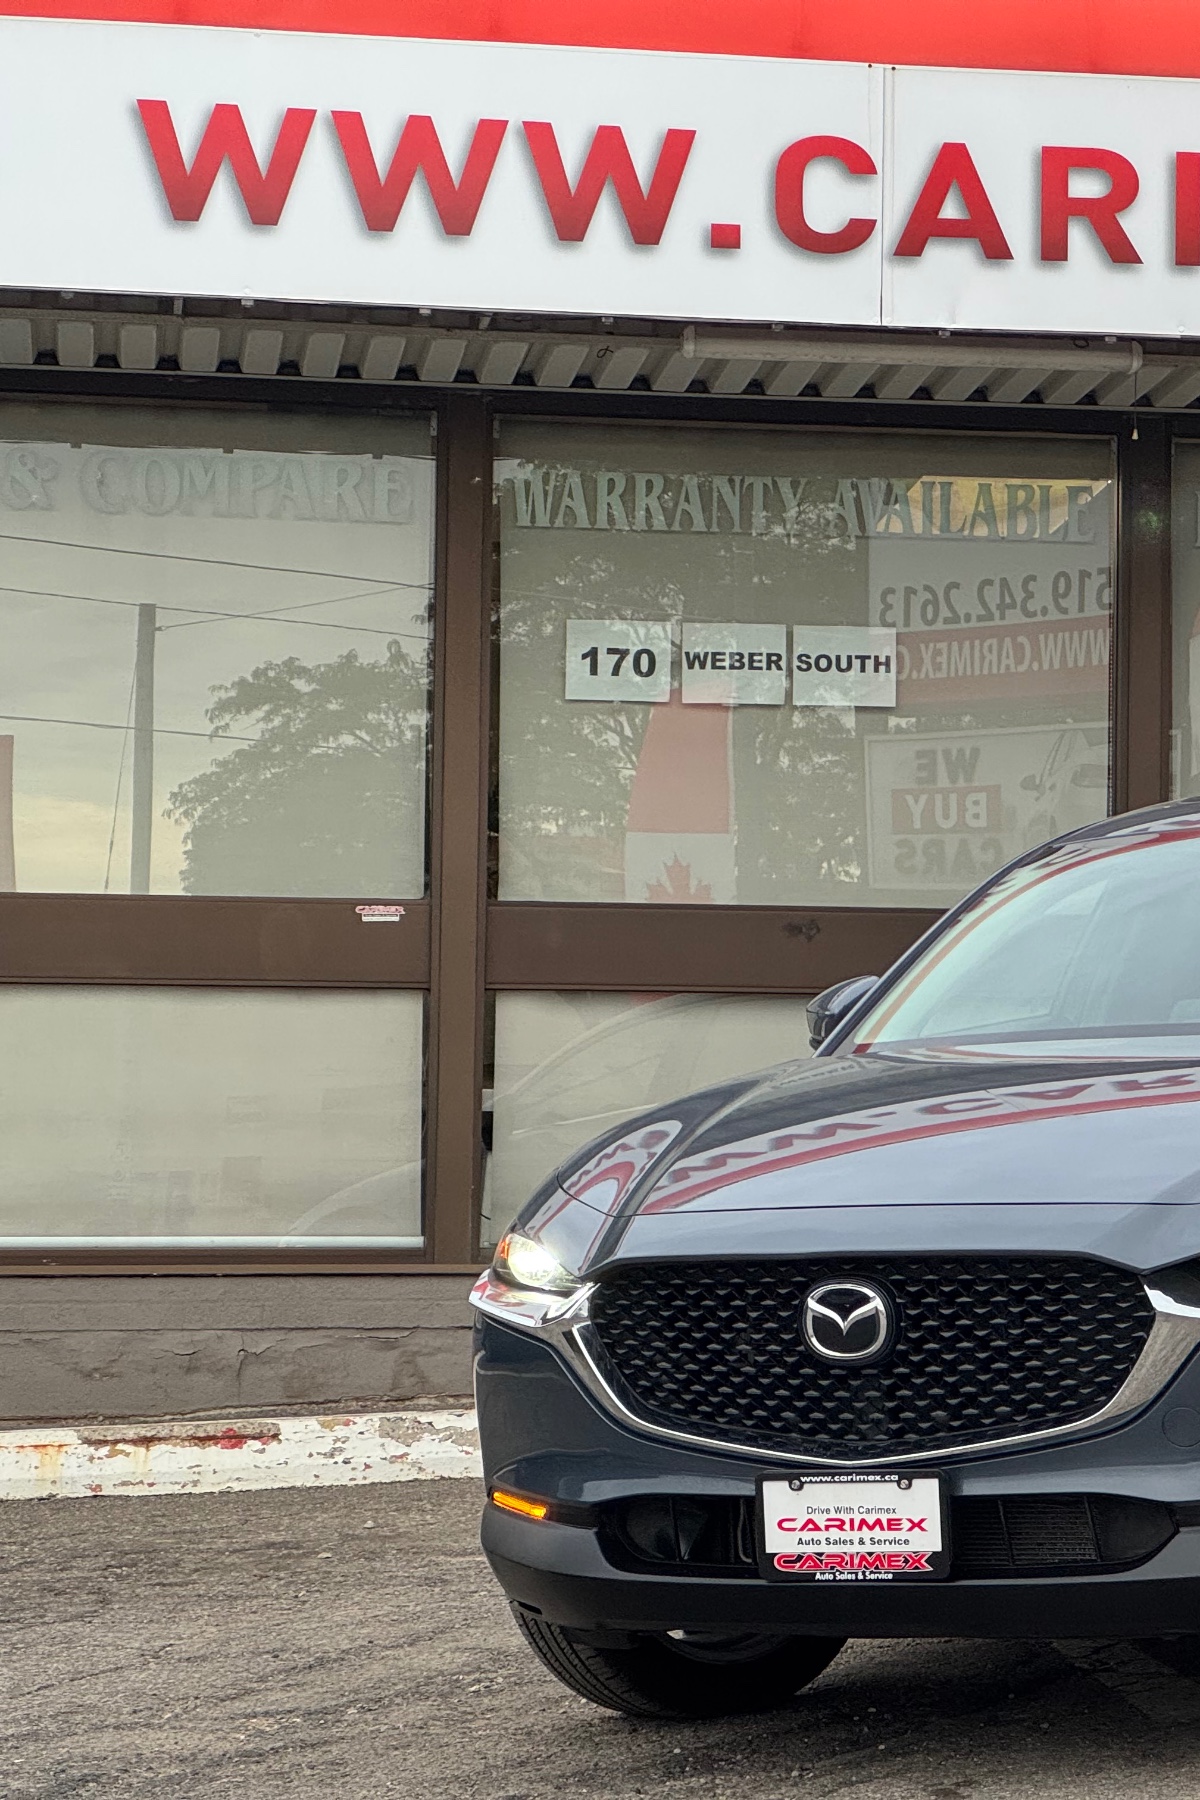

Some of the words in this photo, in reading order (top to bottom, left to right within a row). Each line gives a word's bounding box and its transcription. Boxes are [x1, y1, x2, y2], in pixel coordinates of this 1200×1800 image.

[5, 446, 59, 512] &
[78, 450, 415, 524] COMPARE
[512, 468, 808, 538] WARRANTY
[832, 476, 1096, 543] AVAILABLE
[579, 646, 658, 679] 170
[683, 650, 784, 673] WEBER
[795, 653, 892, 676] SOUTH
[800, 1473, 899, 1483] www.carimex.ca
[806, 1506, 831, 1515] Drive
[833, 1506, 855, 1515] With
[857, 1505, 897, 1515] Carimex
[777, 1517, 928, 1532] CARIMEX
[797, 1537, 822, 1546] Auto
[824, 1537, 855, 1546] Sales
[858, 1537, 866, 1546] &
[869, 1537, 910, 1546] Service
[774, 1552, 933, 1571] CARIMEX
[815, 1572, 834, 1581] Auto
[835, 1571, 856, 1581] Sales
[857, 1571, 864, 1580] &
[865, 1571, 893, 1580] Service
